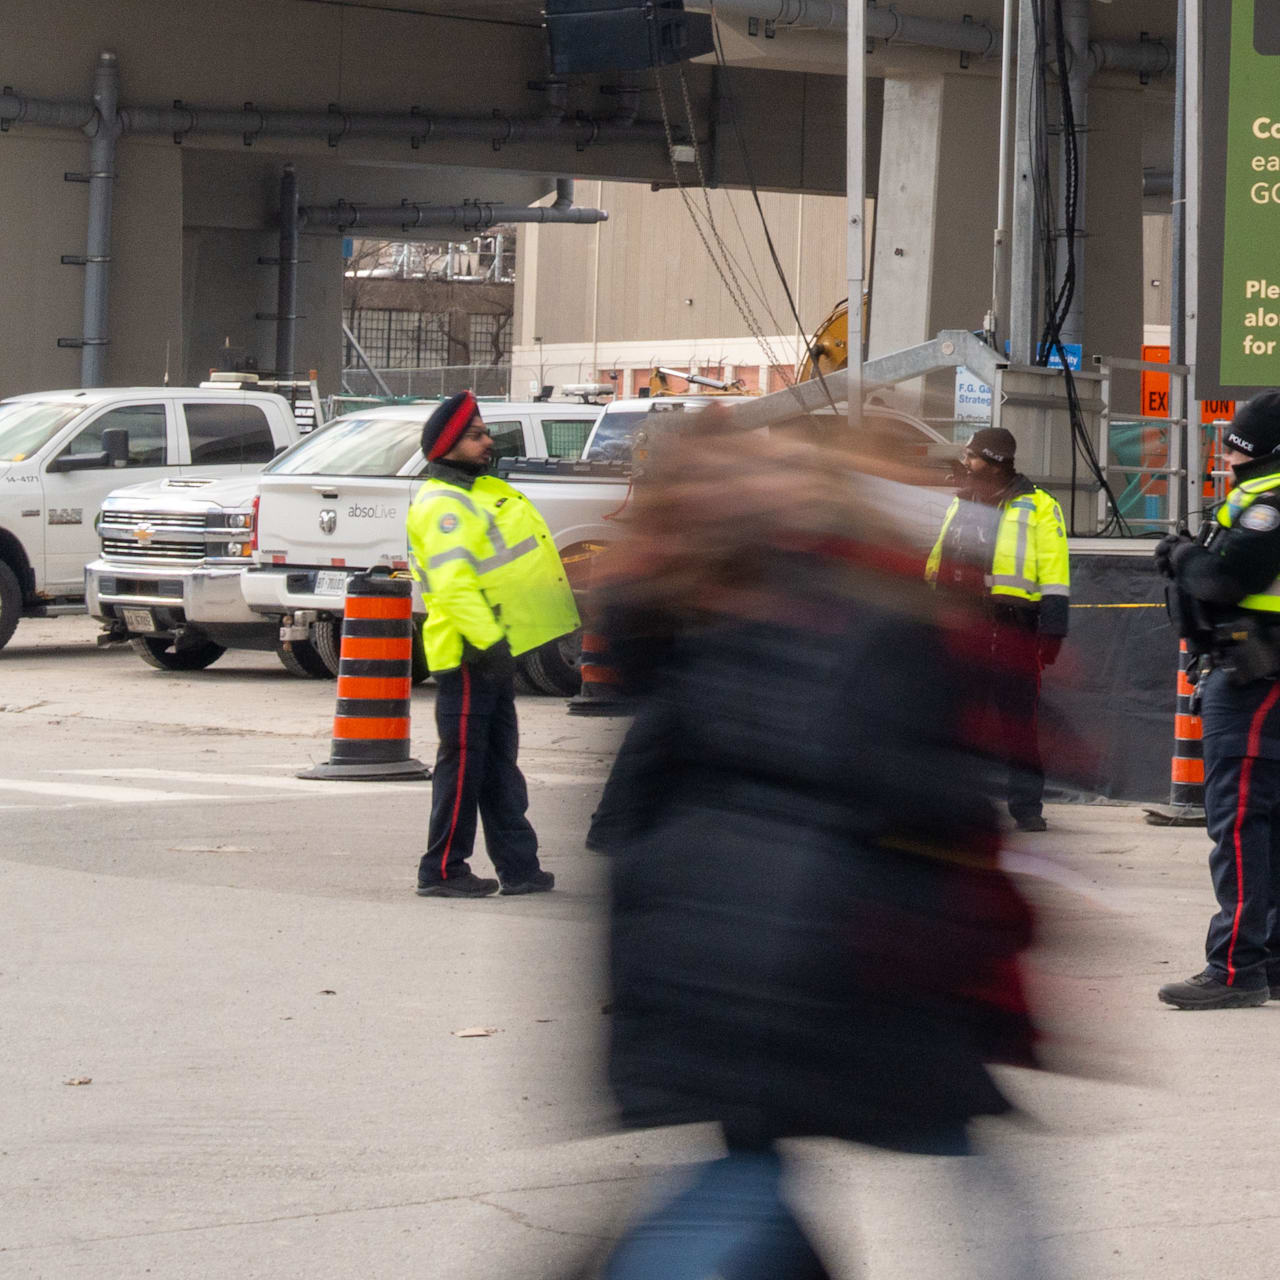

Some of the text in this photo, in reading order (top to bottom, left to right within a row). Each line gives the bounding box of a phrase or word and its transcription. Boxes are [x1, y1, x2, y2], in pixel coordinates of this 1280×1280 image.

[1243, 335, 1276, 356] for
[959, 384, 977, 393] F.G.
[959, 394, 992, 407] Strateg
[1228, 433, 1255, 452] POLICE
[348, 504, 397, 519] absoLive
